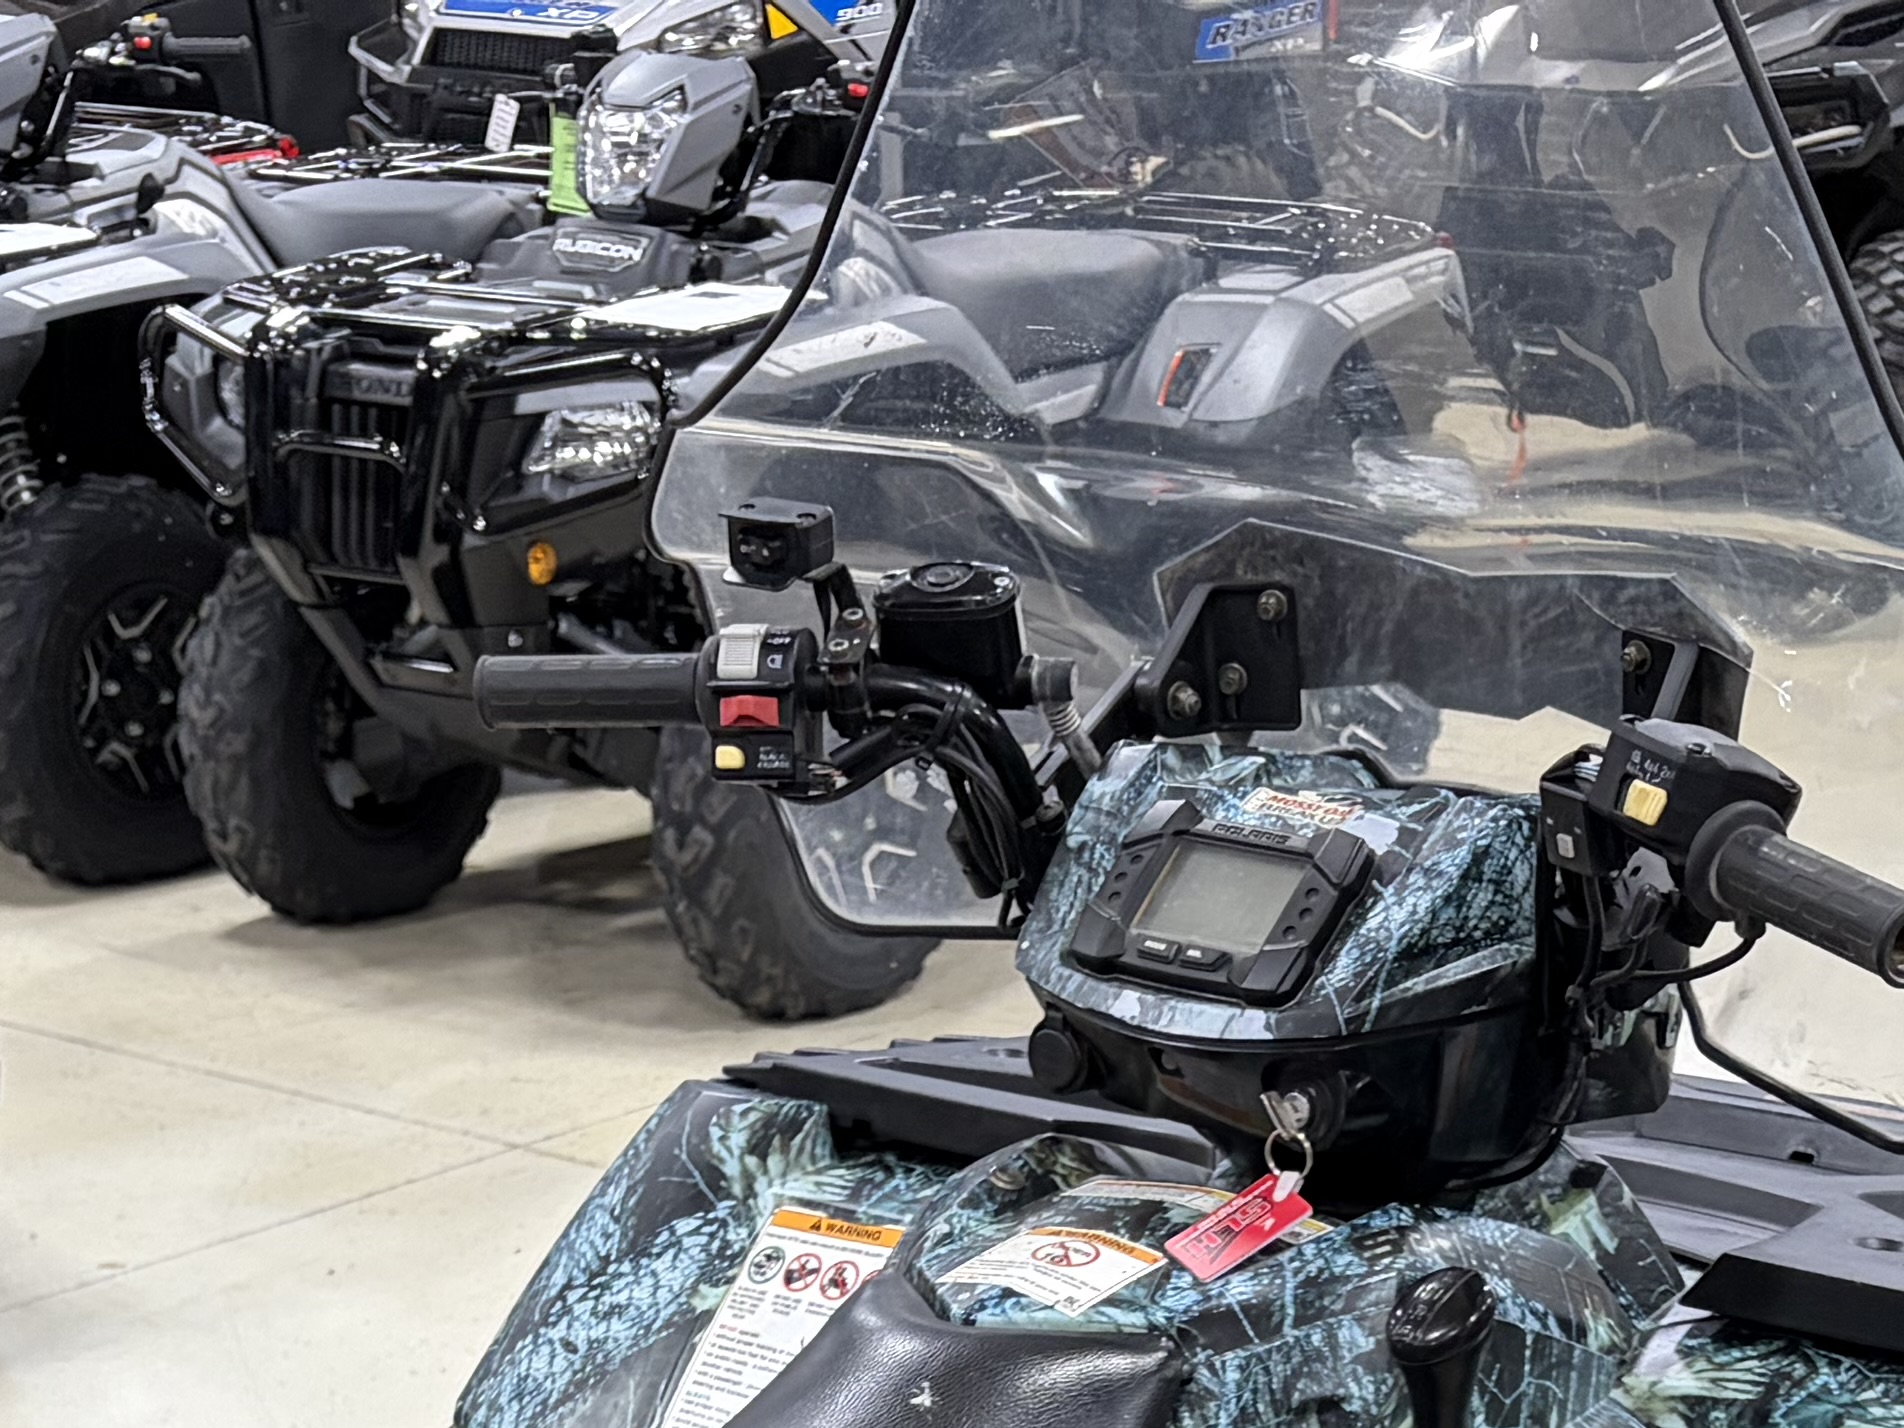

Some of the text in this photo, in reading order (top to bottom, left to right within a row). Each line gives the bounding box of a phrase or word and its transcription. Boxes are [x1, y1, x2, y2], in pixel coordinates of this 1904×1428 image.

[836, 3, 884, 20] 900
[1206, 2, 1319, 48] RANGER
[552, 238, 644, 262] RUBICON
[1212, 822, 1292, 846] POLARIS
[825, 1221, 883, 1242] WARNING
[1064, 1231, 1135, 1256] WARNING
